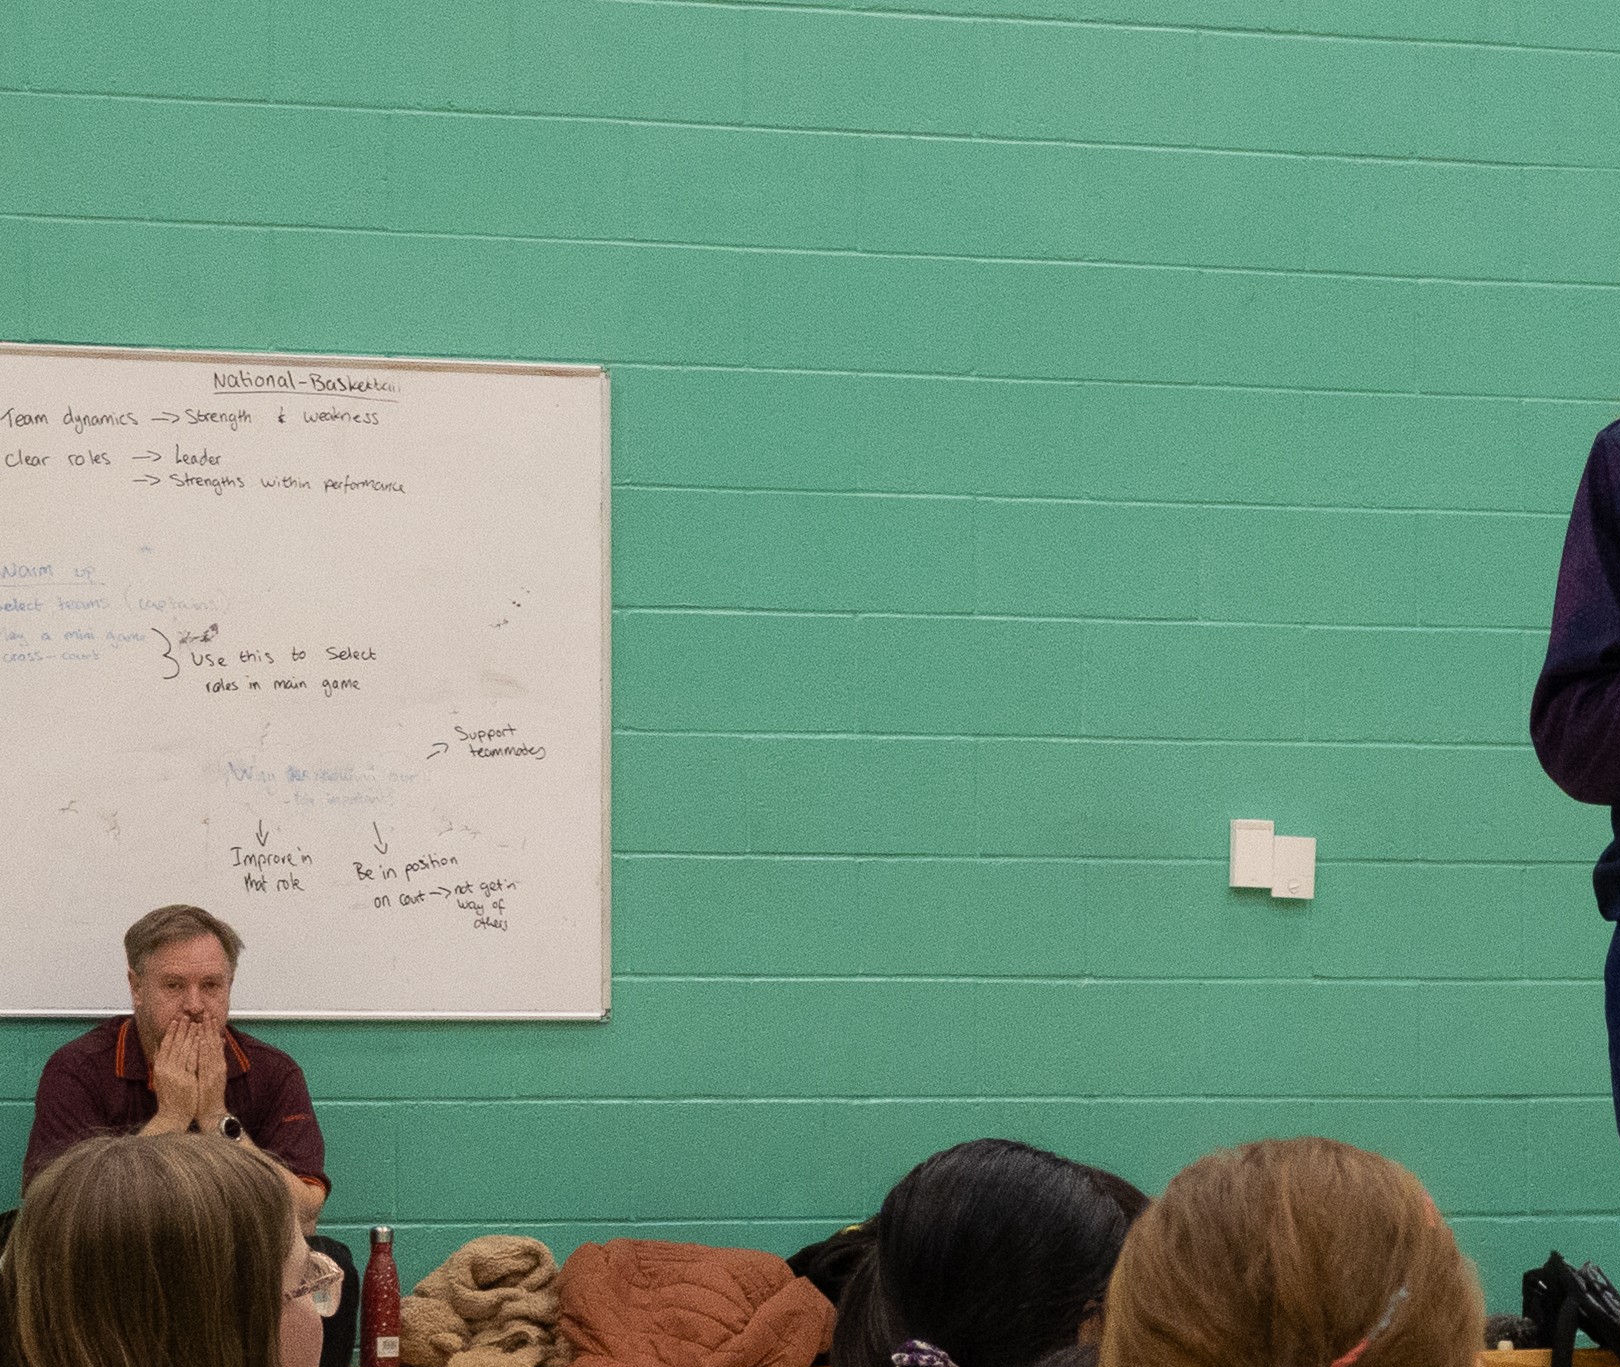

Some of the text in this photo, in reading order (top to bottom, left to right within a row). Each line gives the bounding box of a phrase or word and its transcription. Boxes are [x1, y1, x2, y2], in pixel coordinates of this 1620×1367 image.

[0, 407, 49, 428] Team
[62, 406, 139, 435] dynamics
[184, 408, 251, 432] Strength
[303, 406, 379, 426] weakness
[67, 449, 111, 467] roles
[175, 443, 222, 467] Leader
[168, 472, 406, 497] Strengths within performance
[0, 597, 43, 612] elect
[239, 650, 275, 665] this
[291, 647, 307, 662] to
[205, 676, 360, 698] roles in main game
[453, 723, 517, 743] Support
[468, 743, 546, 761] teammates
[229, 844, 313, 872] Improve in
[352, 854, 458, 882] Be in position
[276, 872, 304, 892] role
[373, 894, 391, 909] on
[453, 880, 474, 895] not
[479, 878, 503, 898] get
[456, 897, 506, 917] way of
